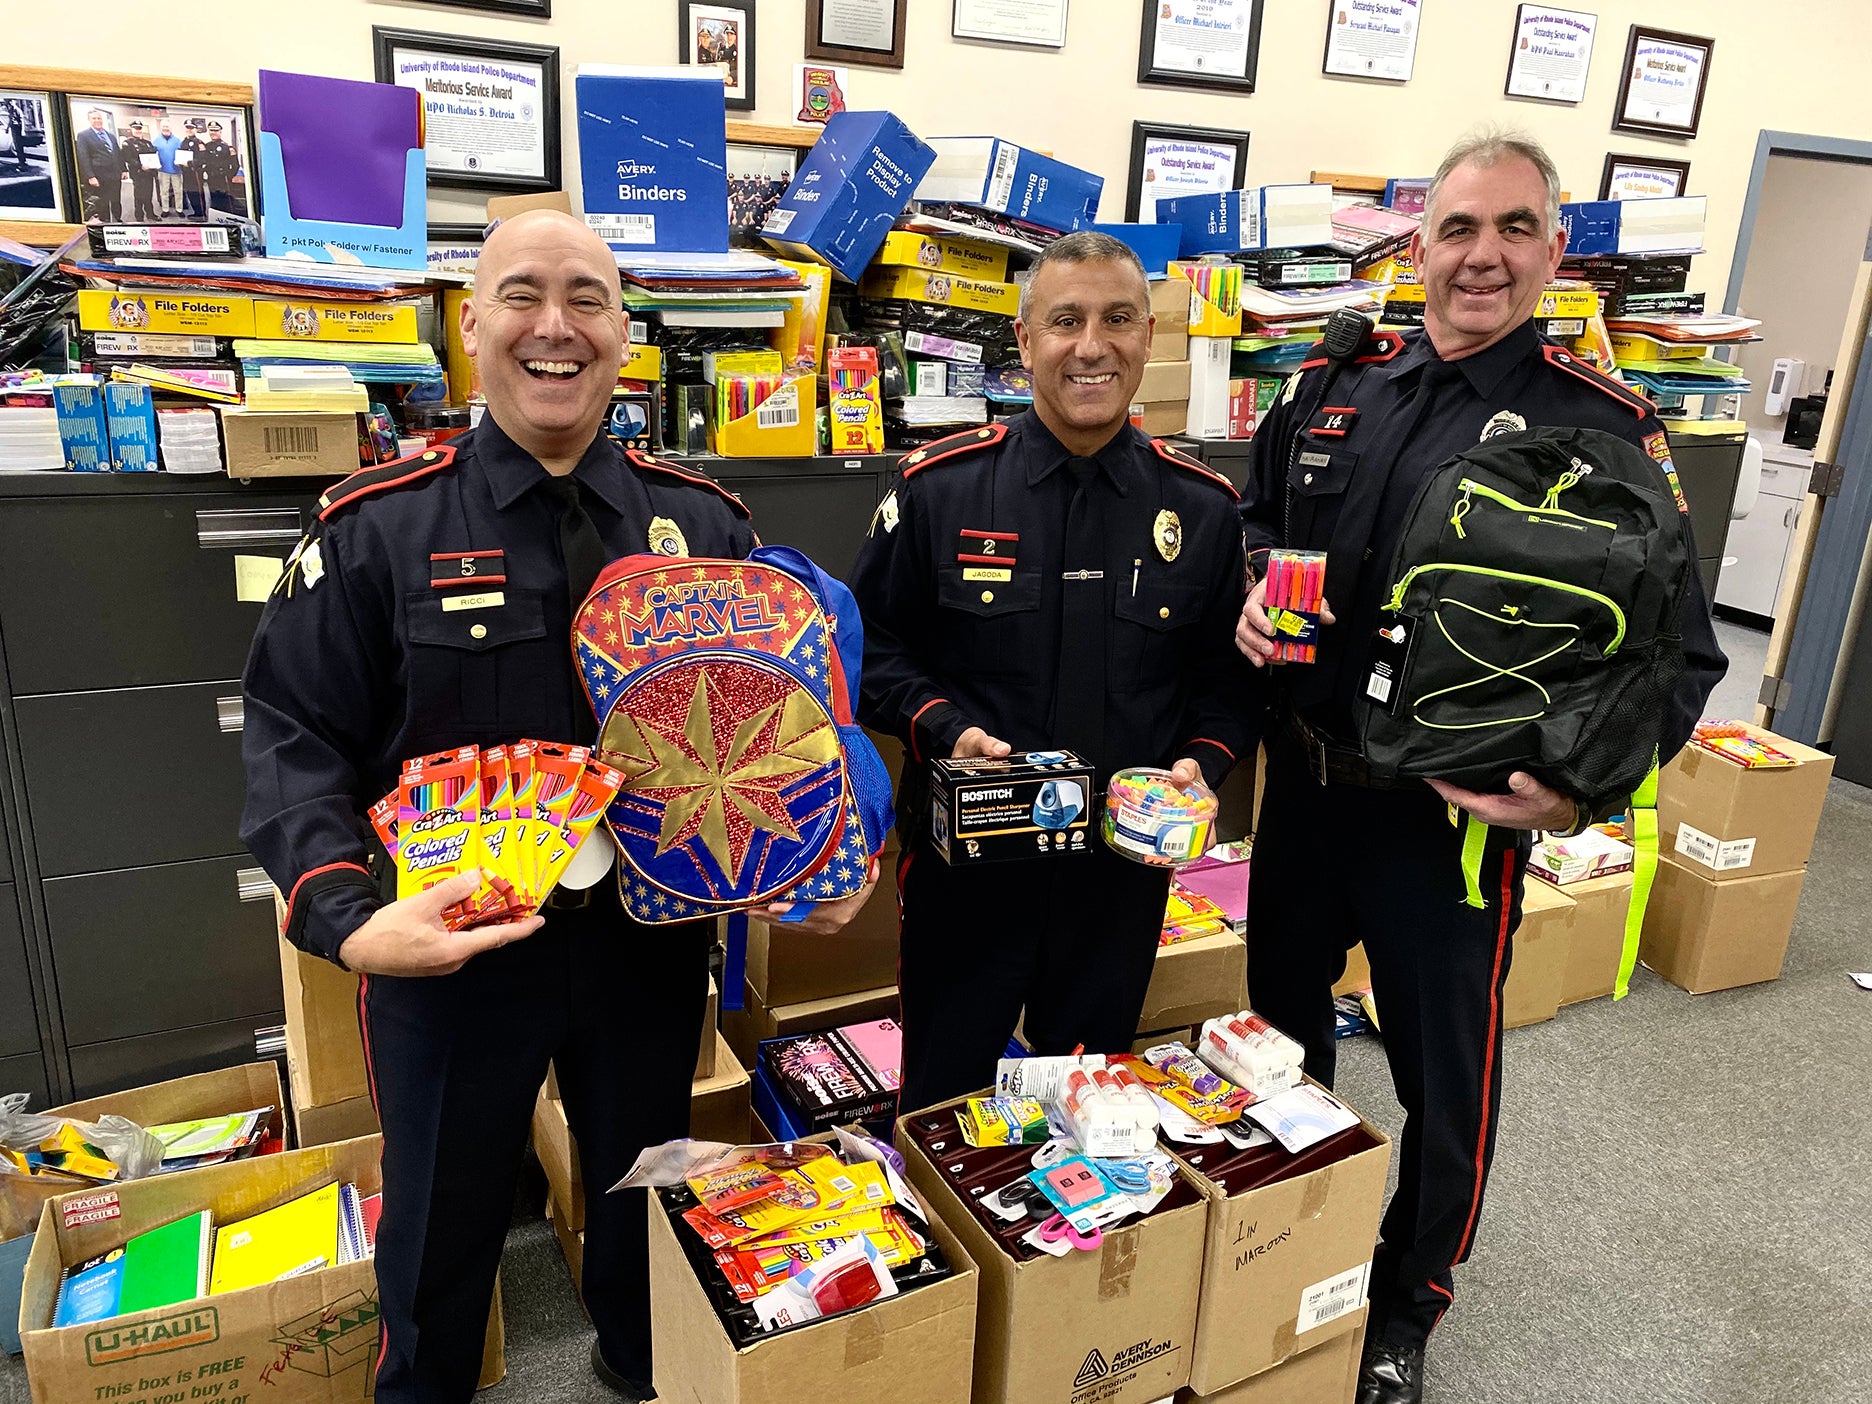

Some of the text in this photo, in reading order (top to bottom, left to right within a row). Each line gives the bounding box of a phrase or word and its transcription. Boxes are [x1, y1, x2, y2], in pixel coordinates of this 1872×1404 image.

[401, 60, 536, 87] University of Rhode Island Police Department
[425, 78, 513, 100] Meritorious Service Award
[447, 103, 477, 116] Nicholas
[872, 145, 913, 185] Remove to
[1161, 157, 1215, 170] Outstanding Service Award
[873, 160, 901, 188] Display
[866, 168, 897, 198] Product
[618, 184, 687, 201] Binders
[793, 188, 821, 202] Binders
[1021, 173, 1038, 218] Binders
[282, 236, 288, 245] 2
[291, 238, 307, 248] pkt
[373, 244, 413, 256] Fastener
[947, 246, 993, 263] File Folders
[443, 250, 469, 260] of Rhode
[956, 280, 1005, 296] File Folders
[154, 300, 230, 313] File Folders
[324, 309, 394, 321] File Folders
[835, 405, 870, 415] Colored
[837, 413, 867, 423] Pencils
[1324, 415, 1343, 428] 14
[846, 431, 863, 445] 12
[983, 539, 996, 555] 2
[461, 558, 476, 576] 5
[972, 570, 1003, 579] JAGODA
[460, 597, 486, 606] RICCI
[648, 582, 743, 606] CAPTAIN
[622, 596, 783, 645] MARVEL
[409, 758, 423, 770] 12
[962, 788, 1013, 802] BOSTITCH
[373, 800, 389, 815] 12
[1010, 814, 1030, 822] personnel
[1121, 809, 1147, 825] STAPLES
[403, 829, 469, 858] Colored
[408, 846, 462, 872] Pencils
[64, 1193, 117, 1212] FRAGILE
[66, 1209, 119, 1226] FRAGILE
[1246, 1221, 1258, 1239] IN
[1235, 1227, 1292, 1271] MAROON
[74, 1268, 117, 1291] Notebook
[80, 1280, 109, 1295] Carnet
[94, 1317, 211, 1352] U-HAUL
[1111, 1340, 1171, 1374] DENNISON
[1112, 1338, 1152, 1363] AVERY
[95, 1356, 246, 1400] This box is FREE
[153, 1379, 239, 1404] you buy a
[1071, 1372, 1137, 1404] Office Products
